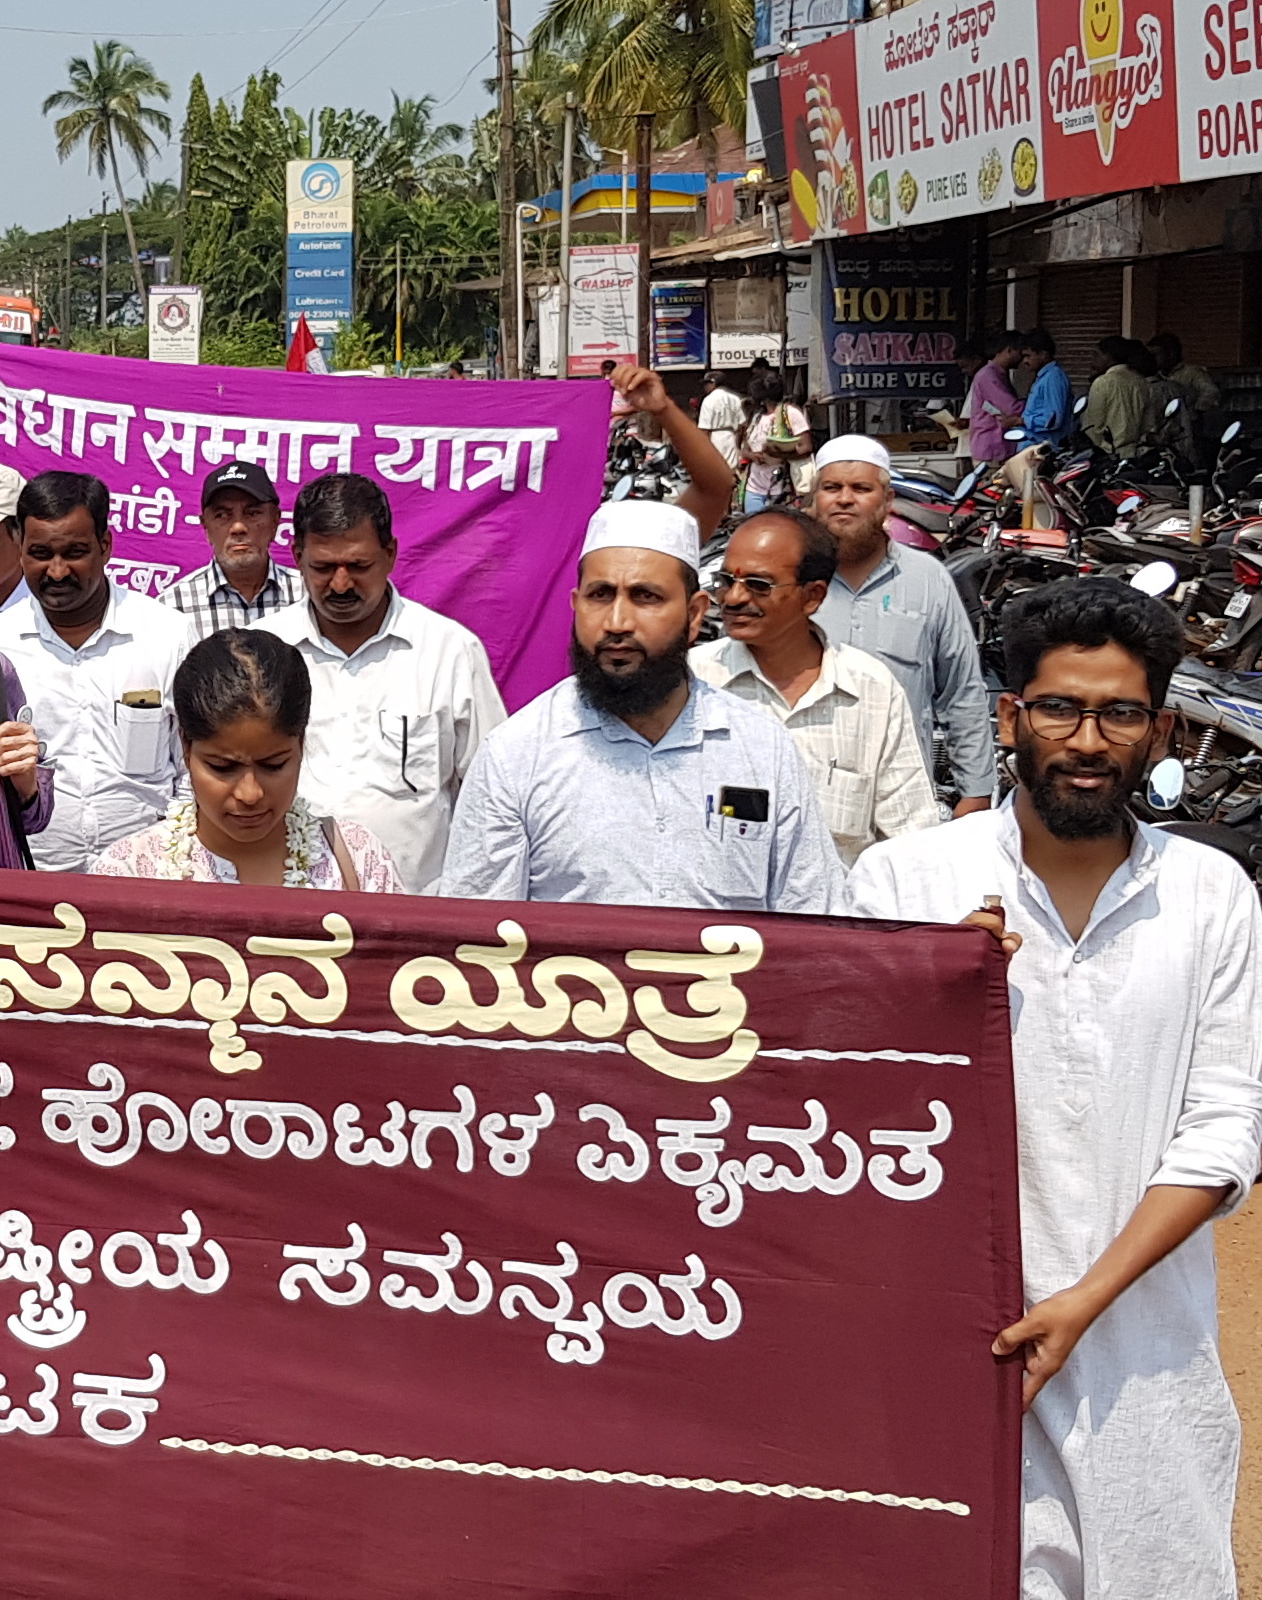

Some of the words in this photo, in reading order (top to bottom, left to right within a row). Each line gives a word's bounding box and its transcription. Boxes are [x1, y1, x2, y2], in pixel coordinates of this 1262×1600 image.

[1051, 26, 1159, 123] Hangyo
[867, 91, 934, 163] HOTEL
[940, 57, 1031, 145] SATKAR
[926, 177, 948, 203] PURE
[949, 172, 968, 198] VEG
[293, 220, 348, 230] Petroleum
[303, 210, 339, 220] Bharat
[294, 269, 322, 278] Credit
[323, 269, 345, 278] Card
[833, 287, 957, 322] HOTEL
[717, 349, 756, 361] TOOLS
[833, 332, 957, 366] SATKAR
[840, 372, 899, 389] PURE
[903, 372, 947, 389] VEG
[142, 406, 362, 484] सम्मान
[374, 423, 559, 493] यात्रा
[389, 918, 765, 1083] ಯಾತ್ರೆ
[41, 1062, 557, 1177] ಹೋರಾಟಗಳ
[278, 1222, 744, 1366] ಸಮನ್ವಯ
